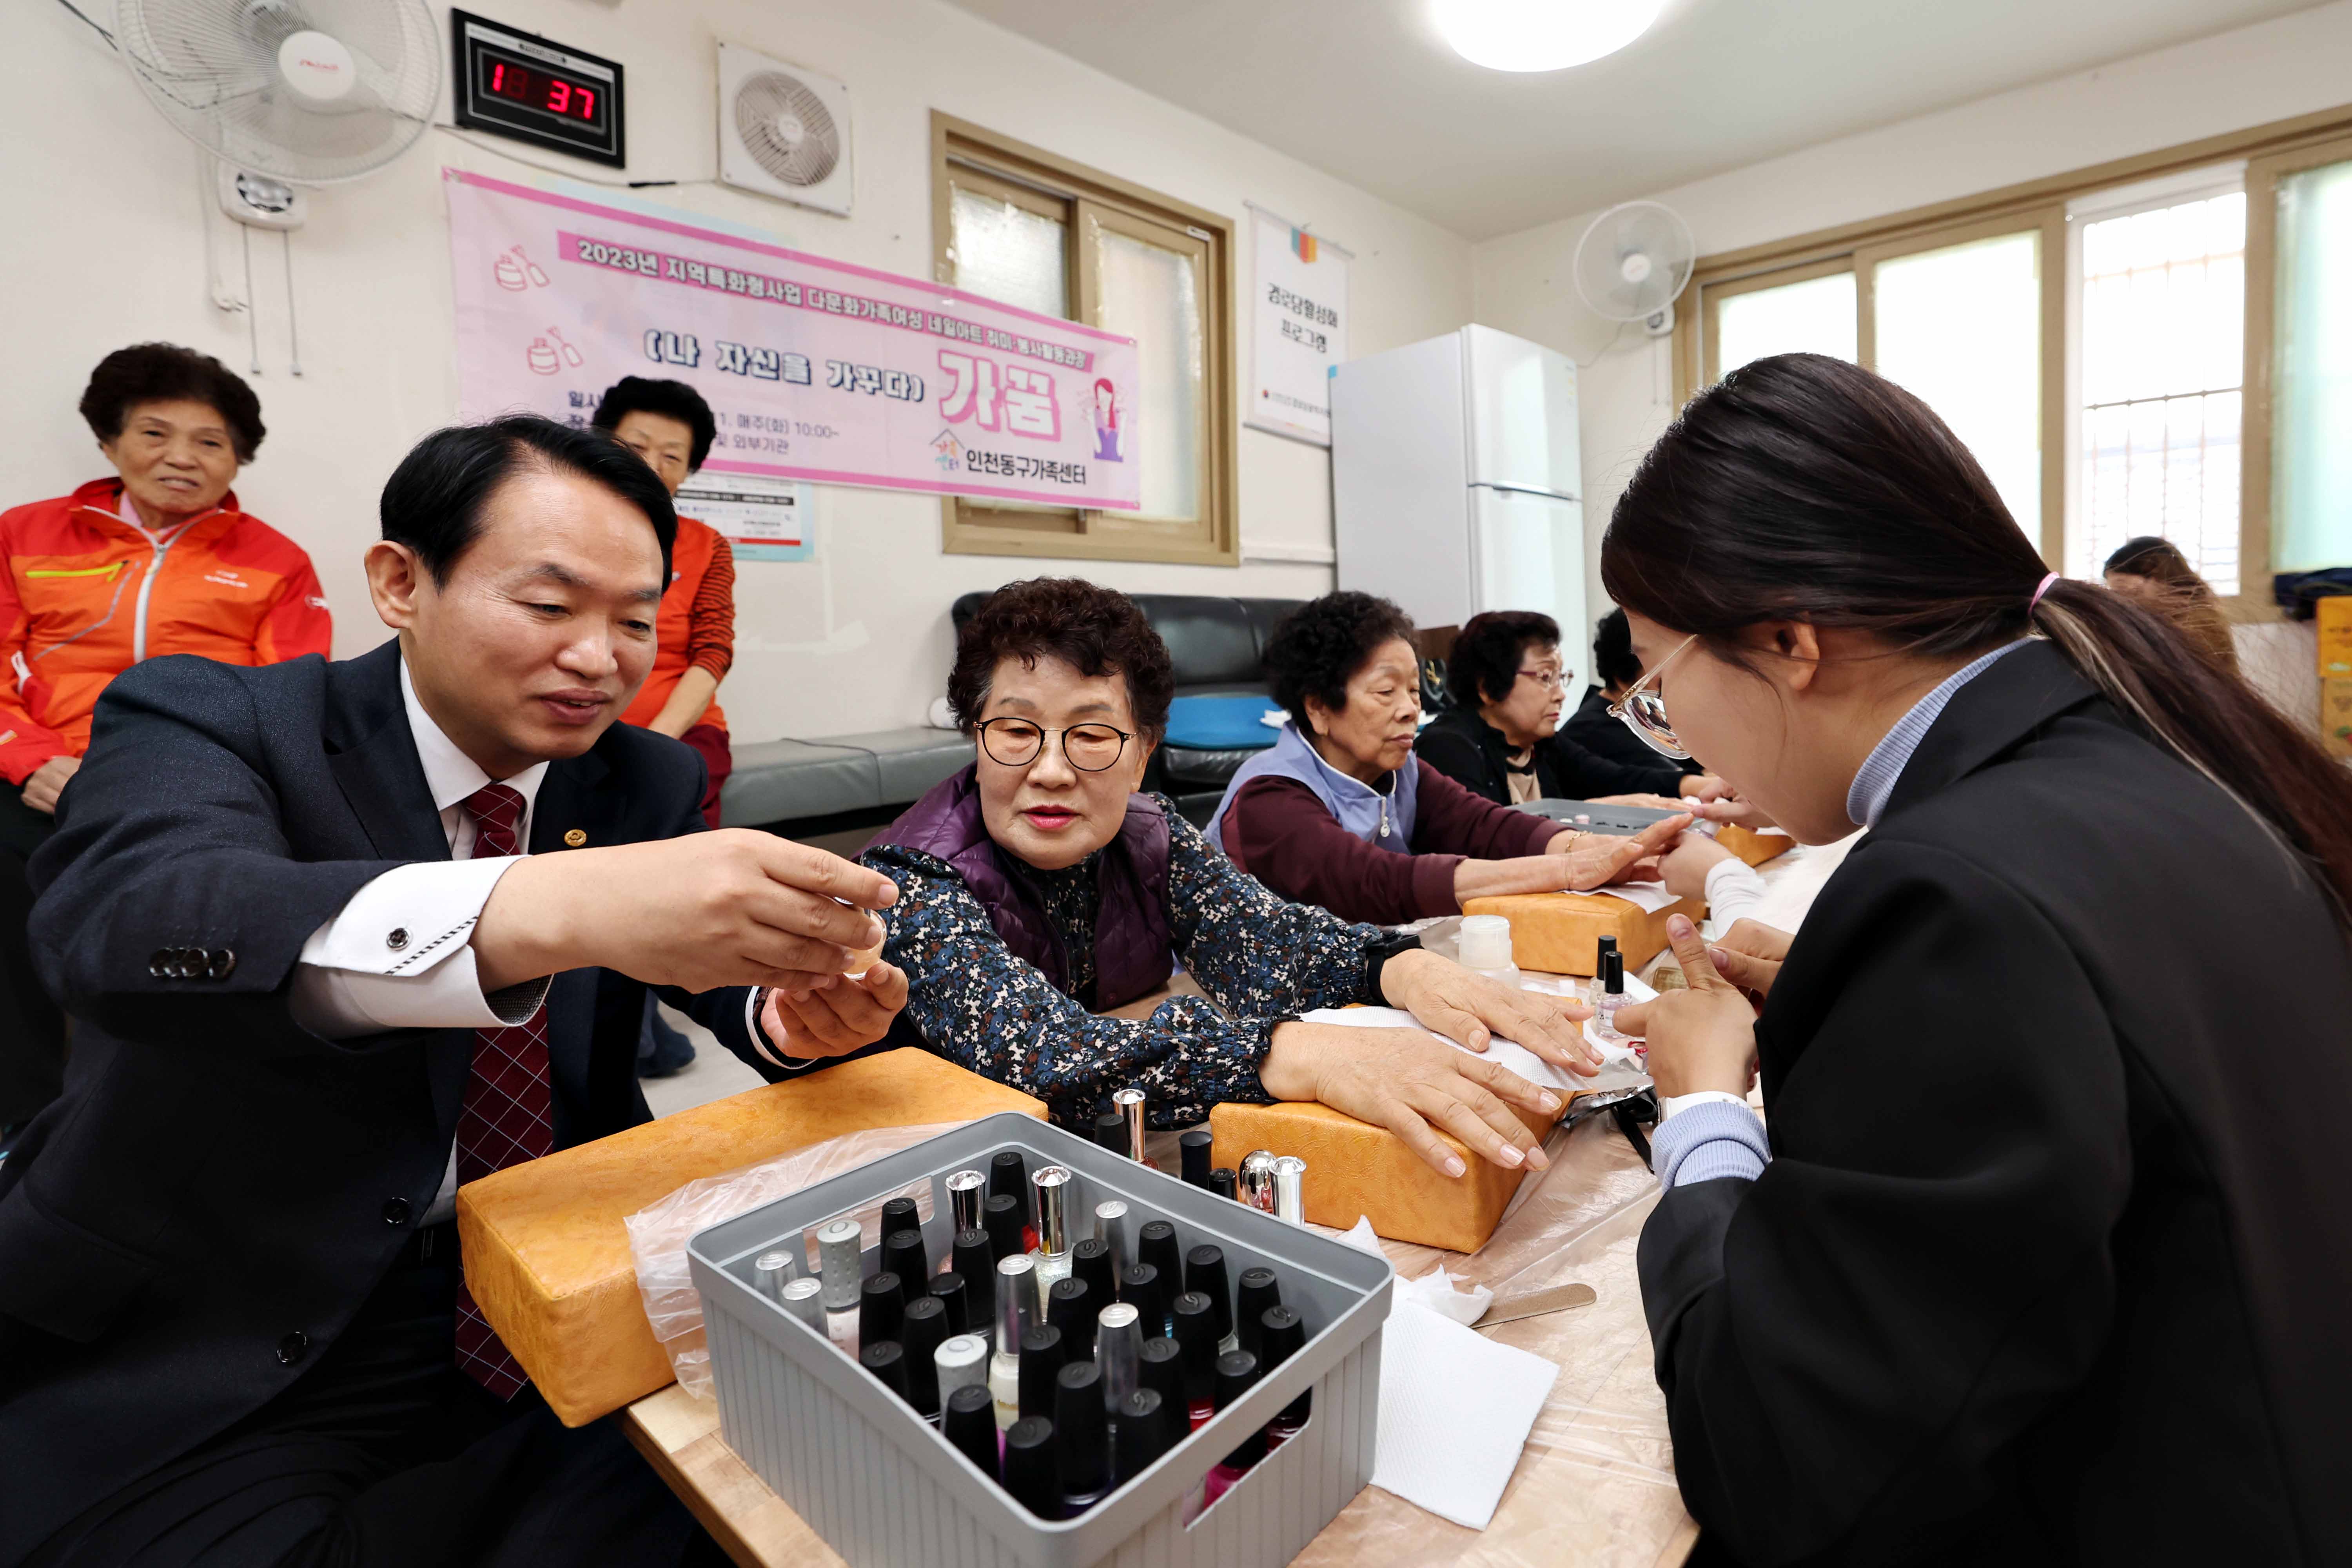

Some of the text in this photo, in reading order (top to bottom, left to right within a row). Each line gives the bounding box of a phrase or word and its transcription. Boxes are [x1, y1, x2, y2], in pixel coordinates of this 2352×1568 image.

[547, 80, 595, 120] 37
[578, 240, 660, 277] 2023년
[667, 256, 802, 307] 지역특화형사업
[807, 287, 924, 330] 다문화가족여성
[928, 314, 983, 344] 네일아트
[1281, 318, 1327, 354] 프로그램
[644, 329, 924, 403] (나 자신을 가꾸다)
[938, 348, 1061, 442] 가꿈
[733, 434, 789, 455] 외부기관
[966, 449, 1086, 485] 인천동구가족센터
